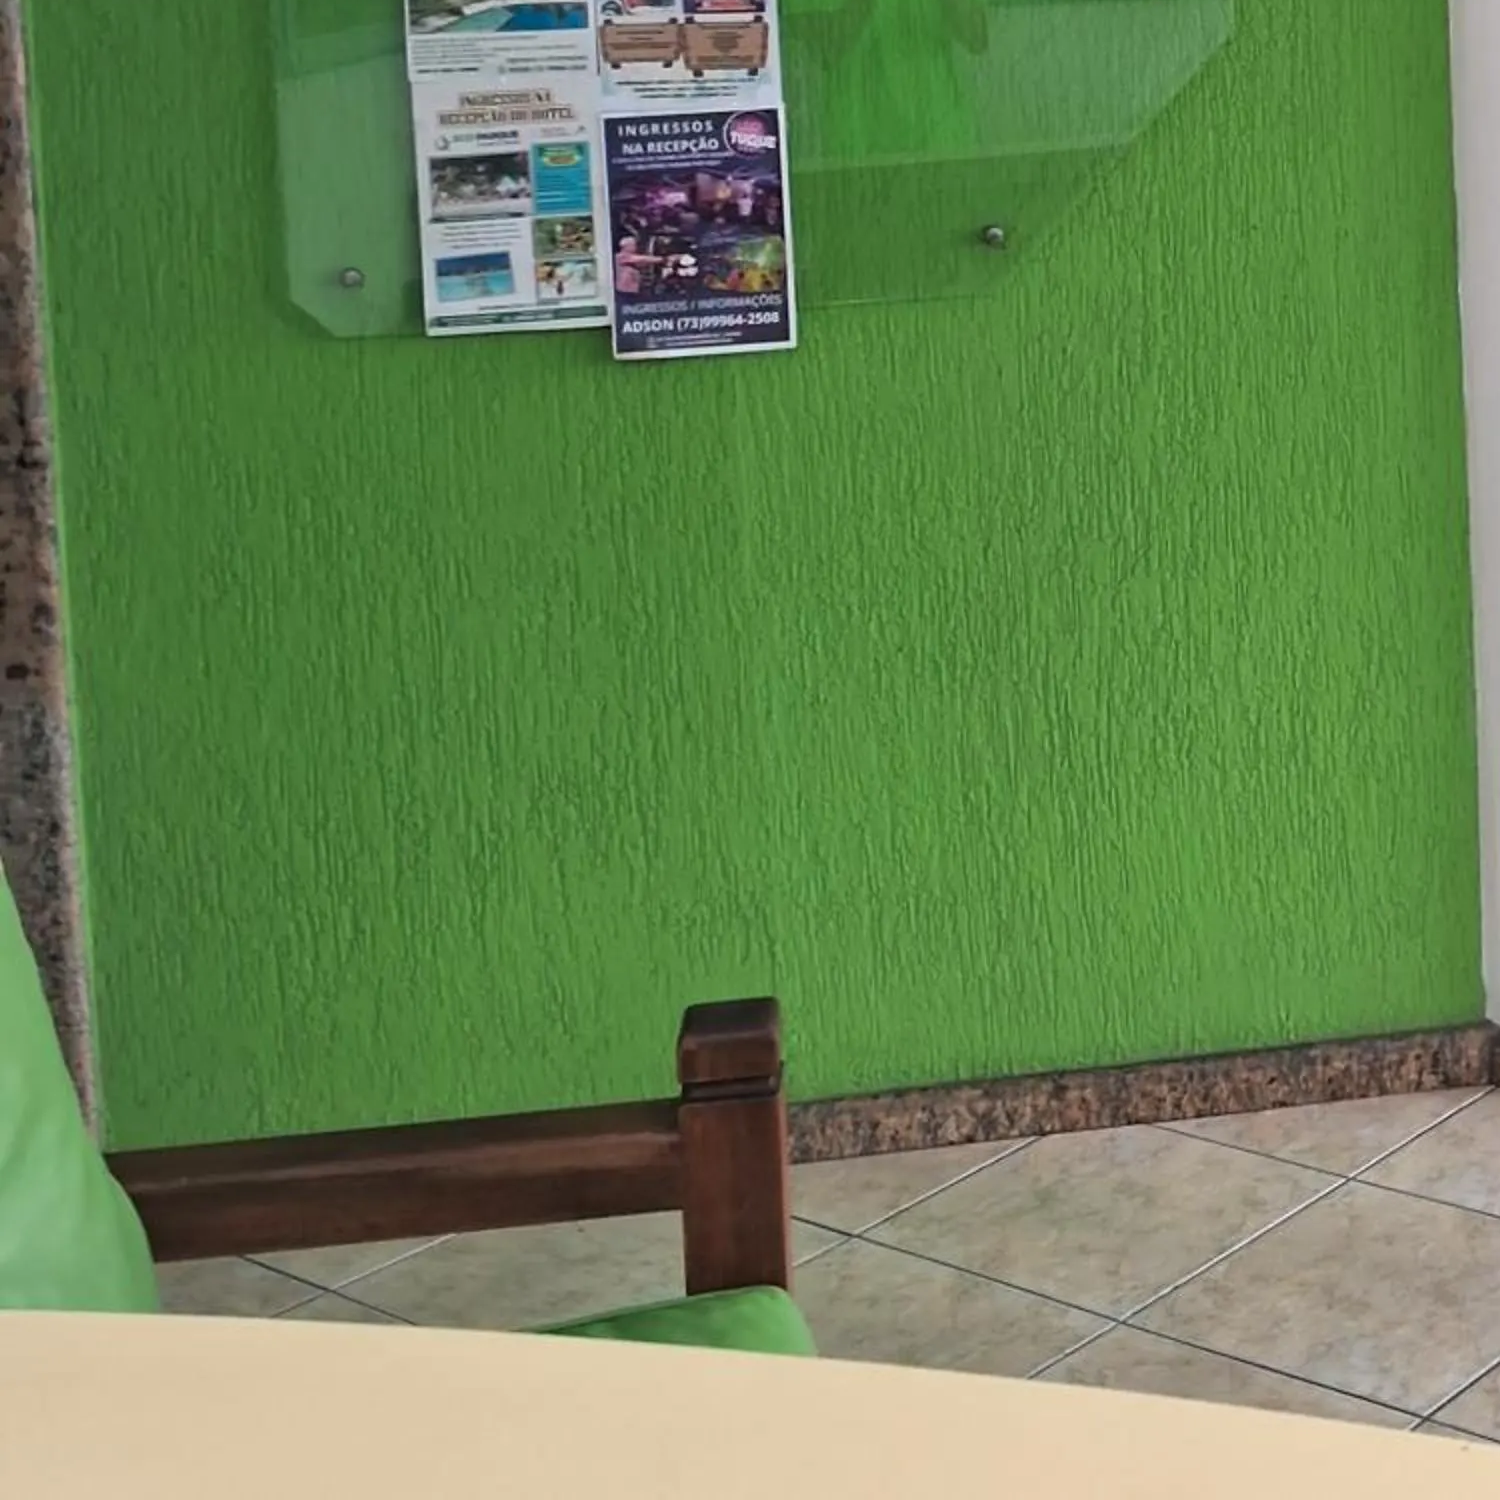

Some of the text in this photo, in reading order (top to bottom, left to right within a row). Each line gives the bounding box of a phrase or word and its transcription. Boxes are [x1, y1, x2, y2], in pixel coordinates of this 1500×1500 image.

[618, 119, 713, 137] INGRESSOS
[622, 136, 719, 155] NA RECEPÇÃO
[621, 301, 688, 315] INGRESSOS
[698, 293, 783, 309] INFORMAÇÕES
[622, 318, 673, 333] ADSON
